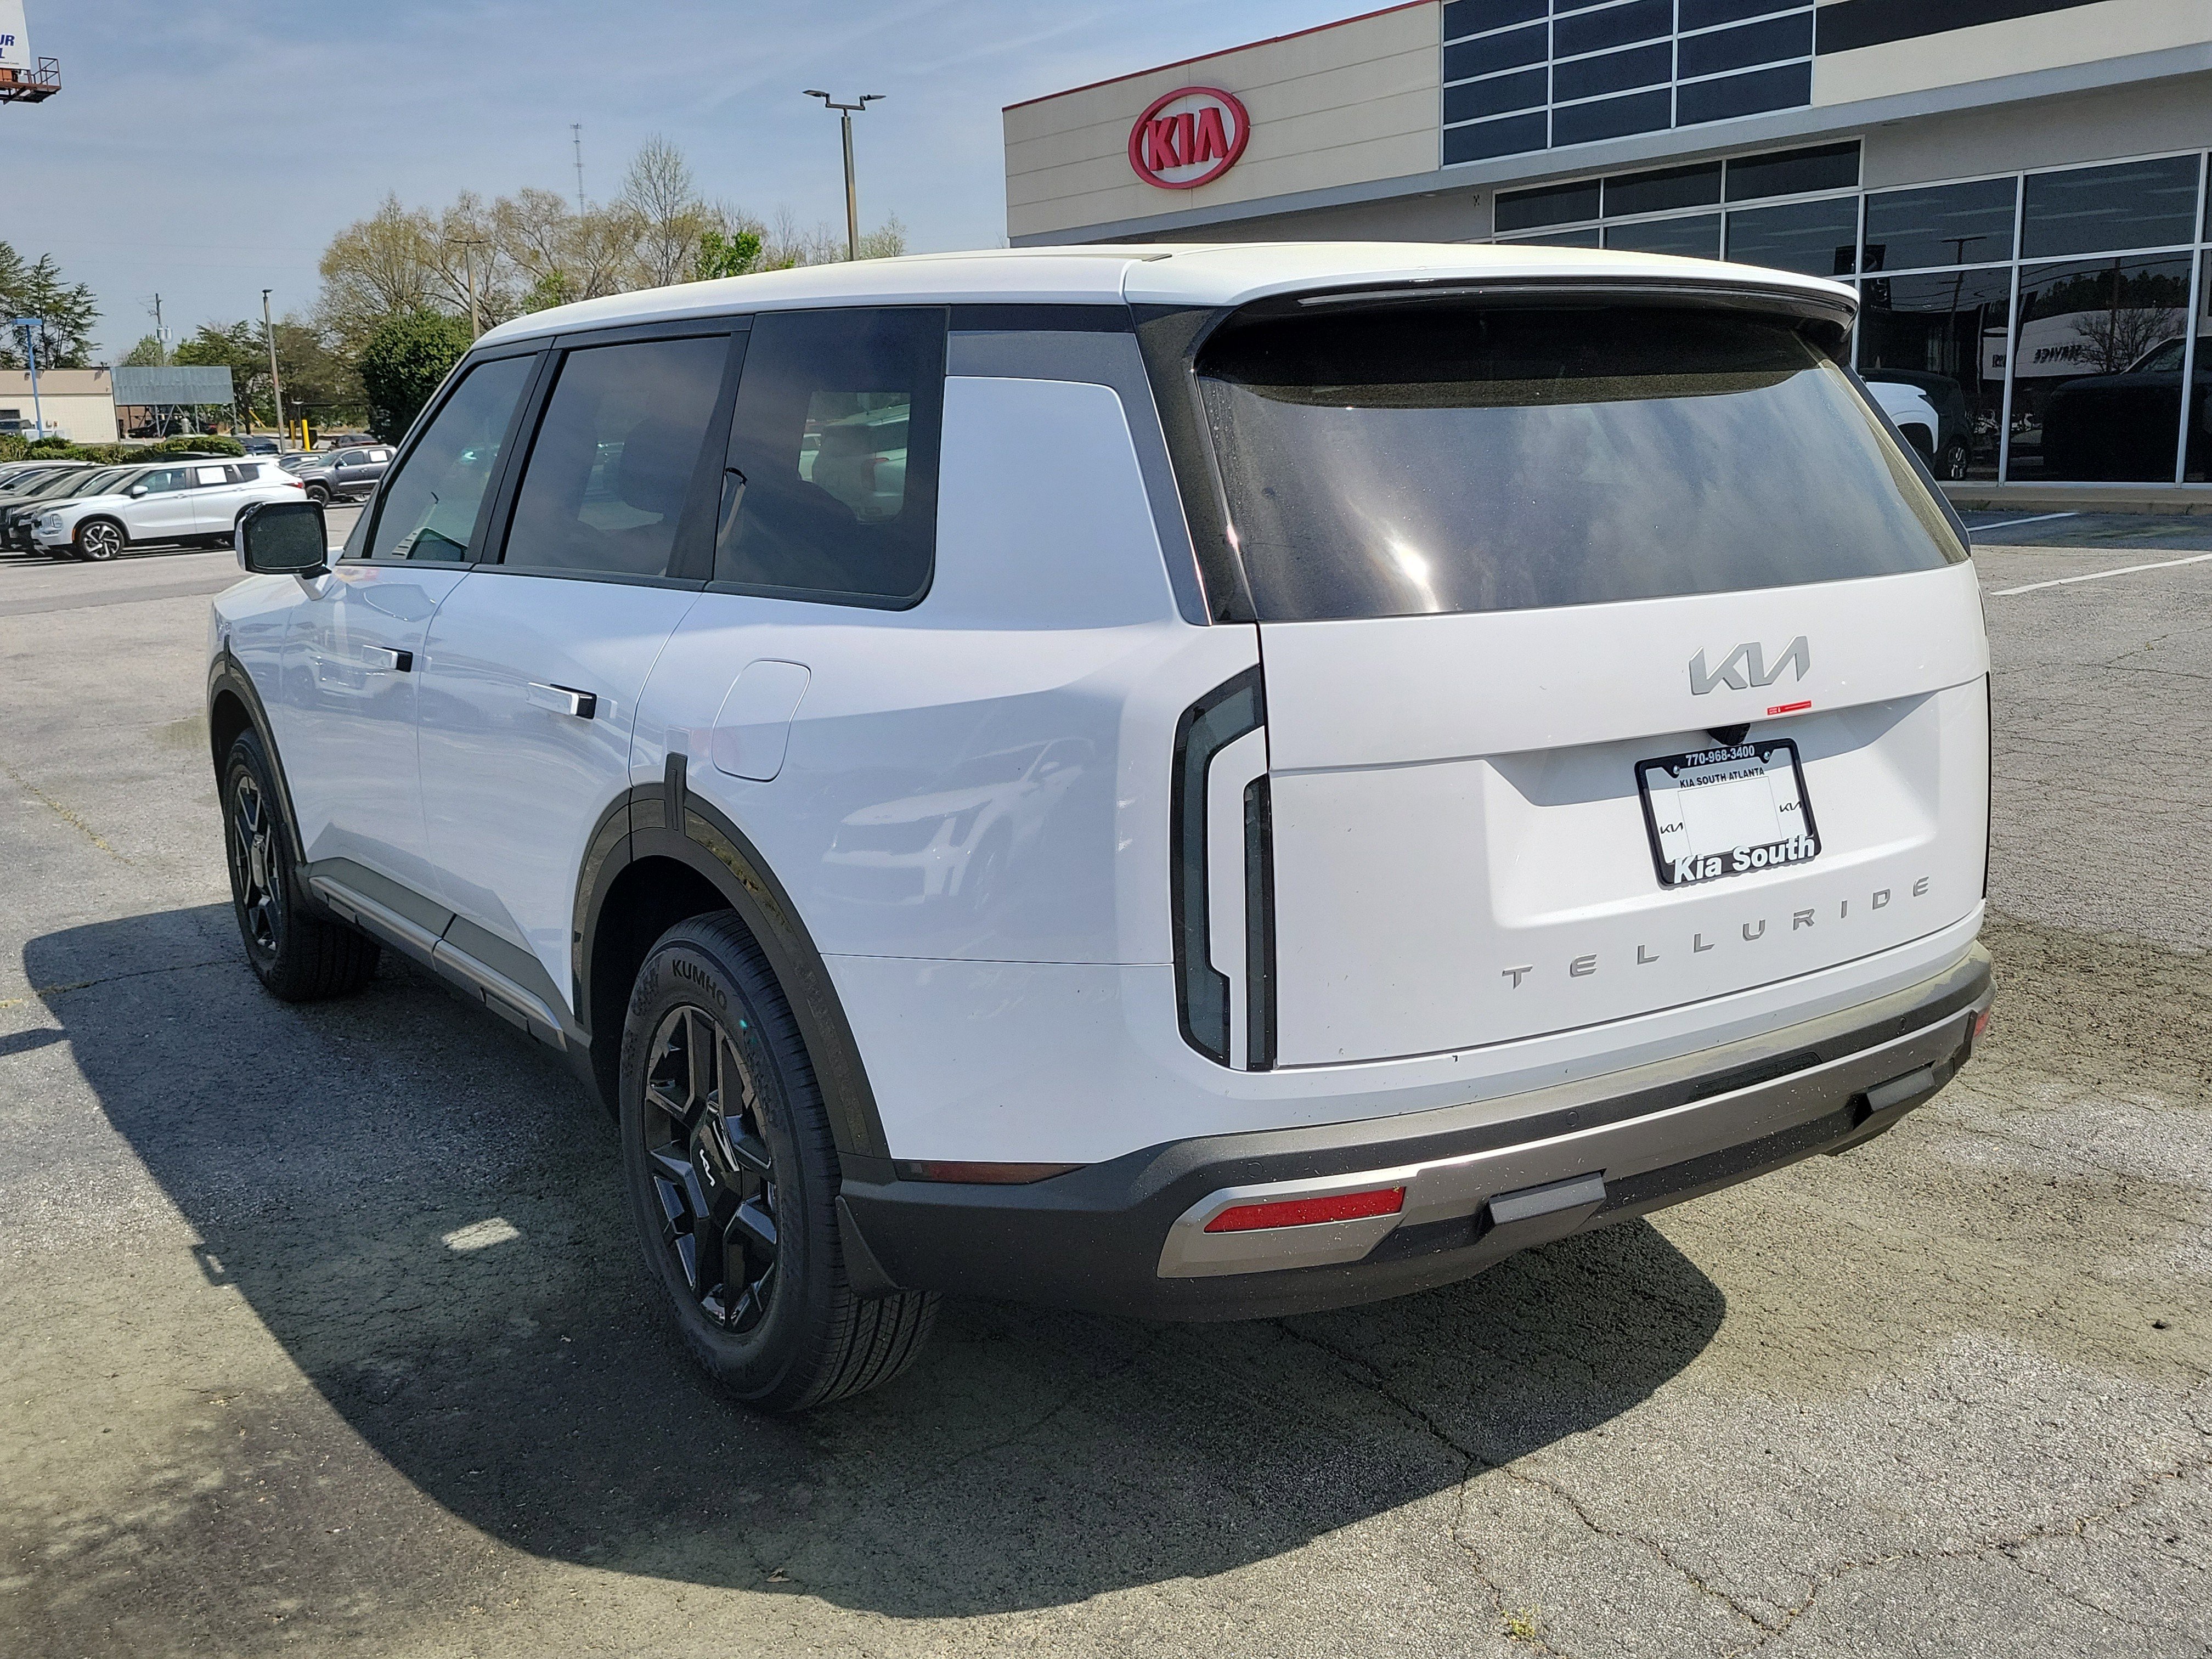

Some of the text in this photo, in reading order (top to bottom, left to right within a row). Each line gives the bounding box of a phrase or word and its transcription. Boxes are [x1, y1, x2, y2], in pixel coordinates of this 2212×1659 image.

[1146, 106, 1229, 171] KIA
[1689, 635, 1810, 696] KIA
[1680, 767, 1765, 789] KIA SOUTH ATLANTA
[1685, 745, 1755, 766] 770-968-3400
[1673, 834, 1815, 884] Kia South
[1502, 876, 1930, 989] TELLURIDE
[672, 960, 727, 1011] KUMHO
